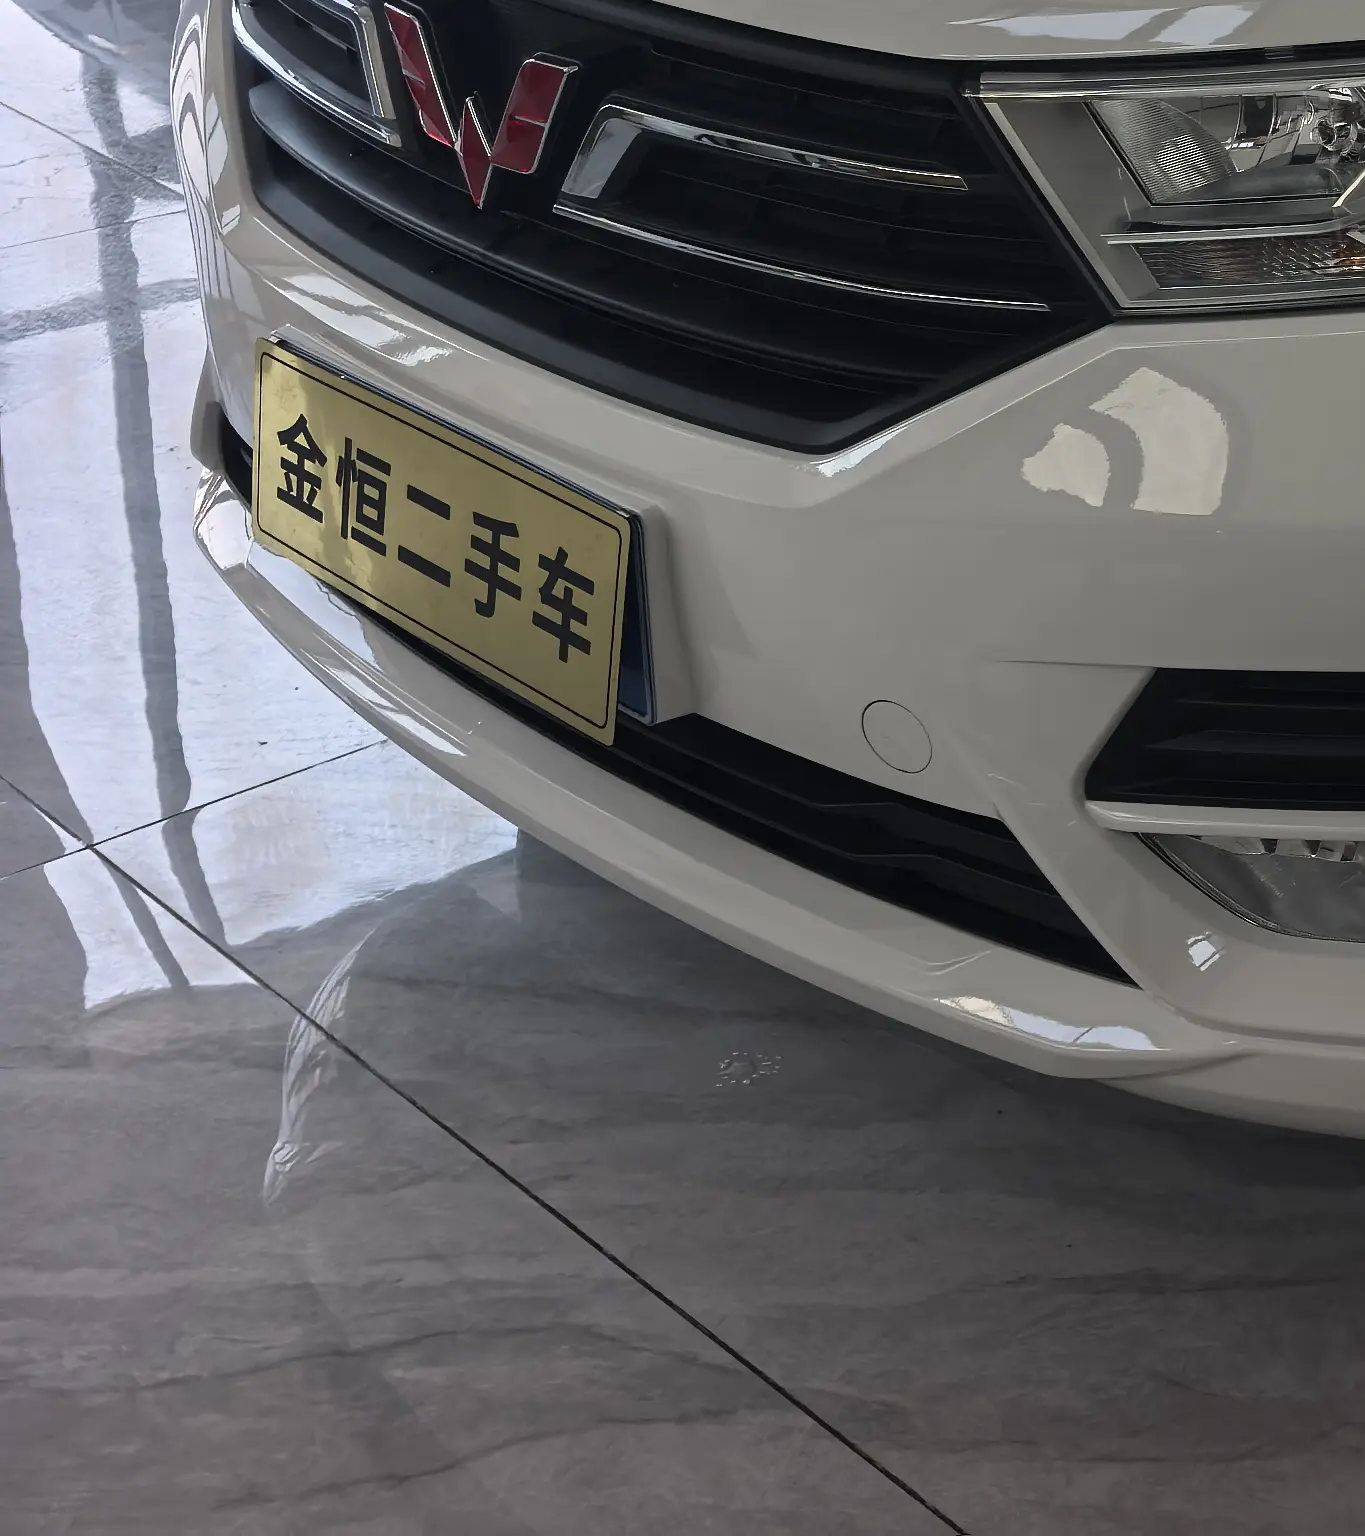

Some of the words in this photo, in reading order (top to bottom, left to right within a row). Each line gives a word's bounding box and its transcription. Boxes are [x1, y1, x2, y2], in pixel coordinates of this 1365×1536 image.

[276, 413, 596, 664] 金恒二手车
